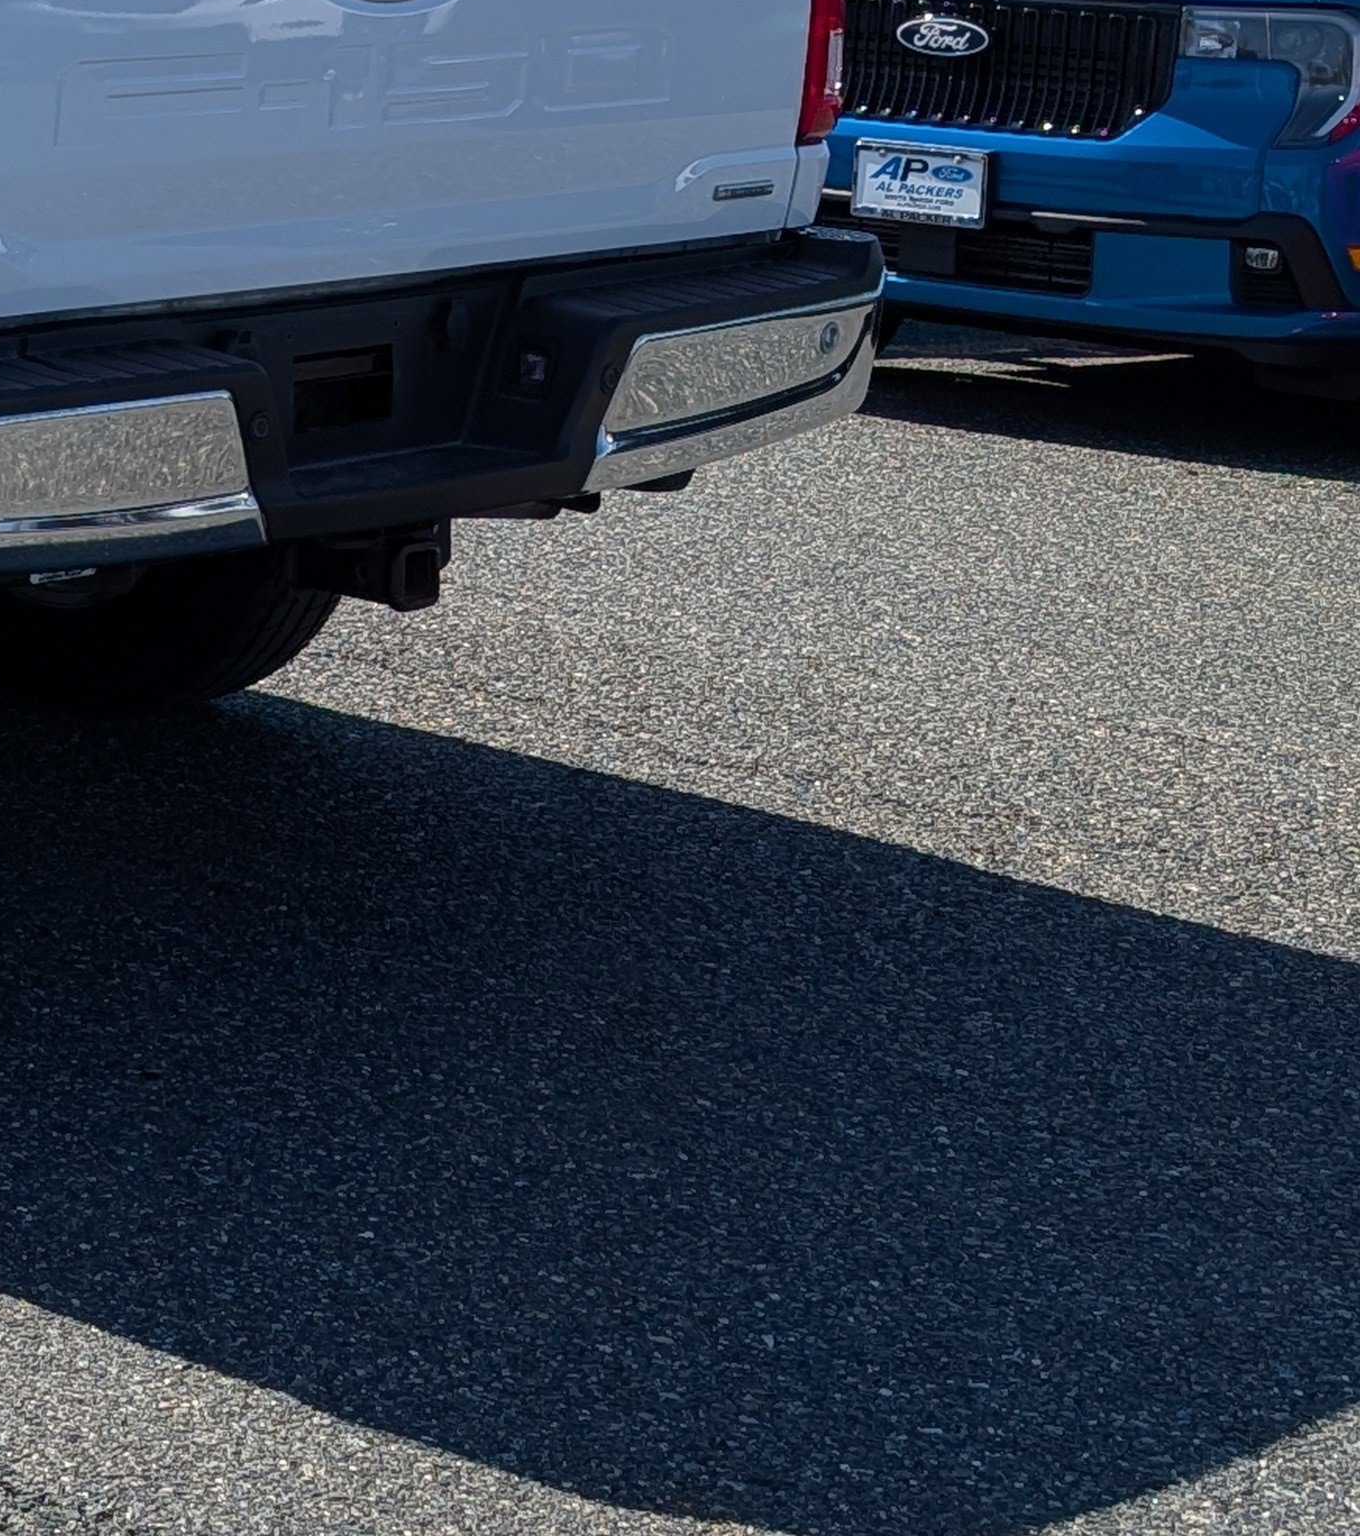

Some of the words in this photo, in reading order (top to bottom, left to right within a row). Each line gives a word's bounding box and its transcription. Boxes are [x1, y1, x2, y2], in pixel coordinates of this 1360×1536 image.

[913, 23, 971, 50] Ford
[869, 155, 929, 182] AP
[875, 180, 895, 193] AL
[898, 182, 964, 200] PACKERS
